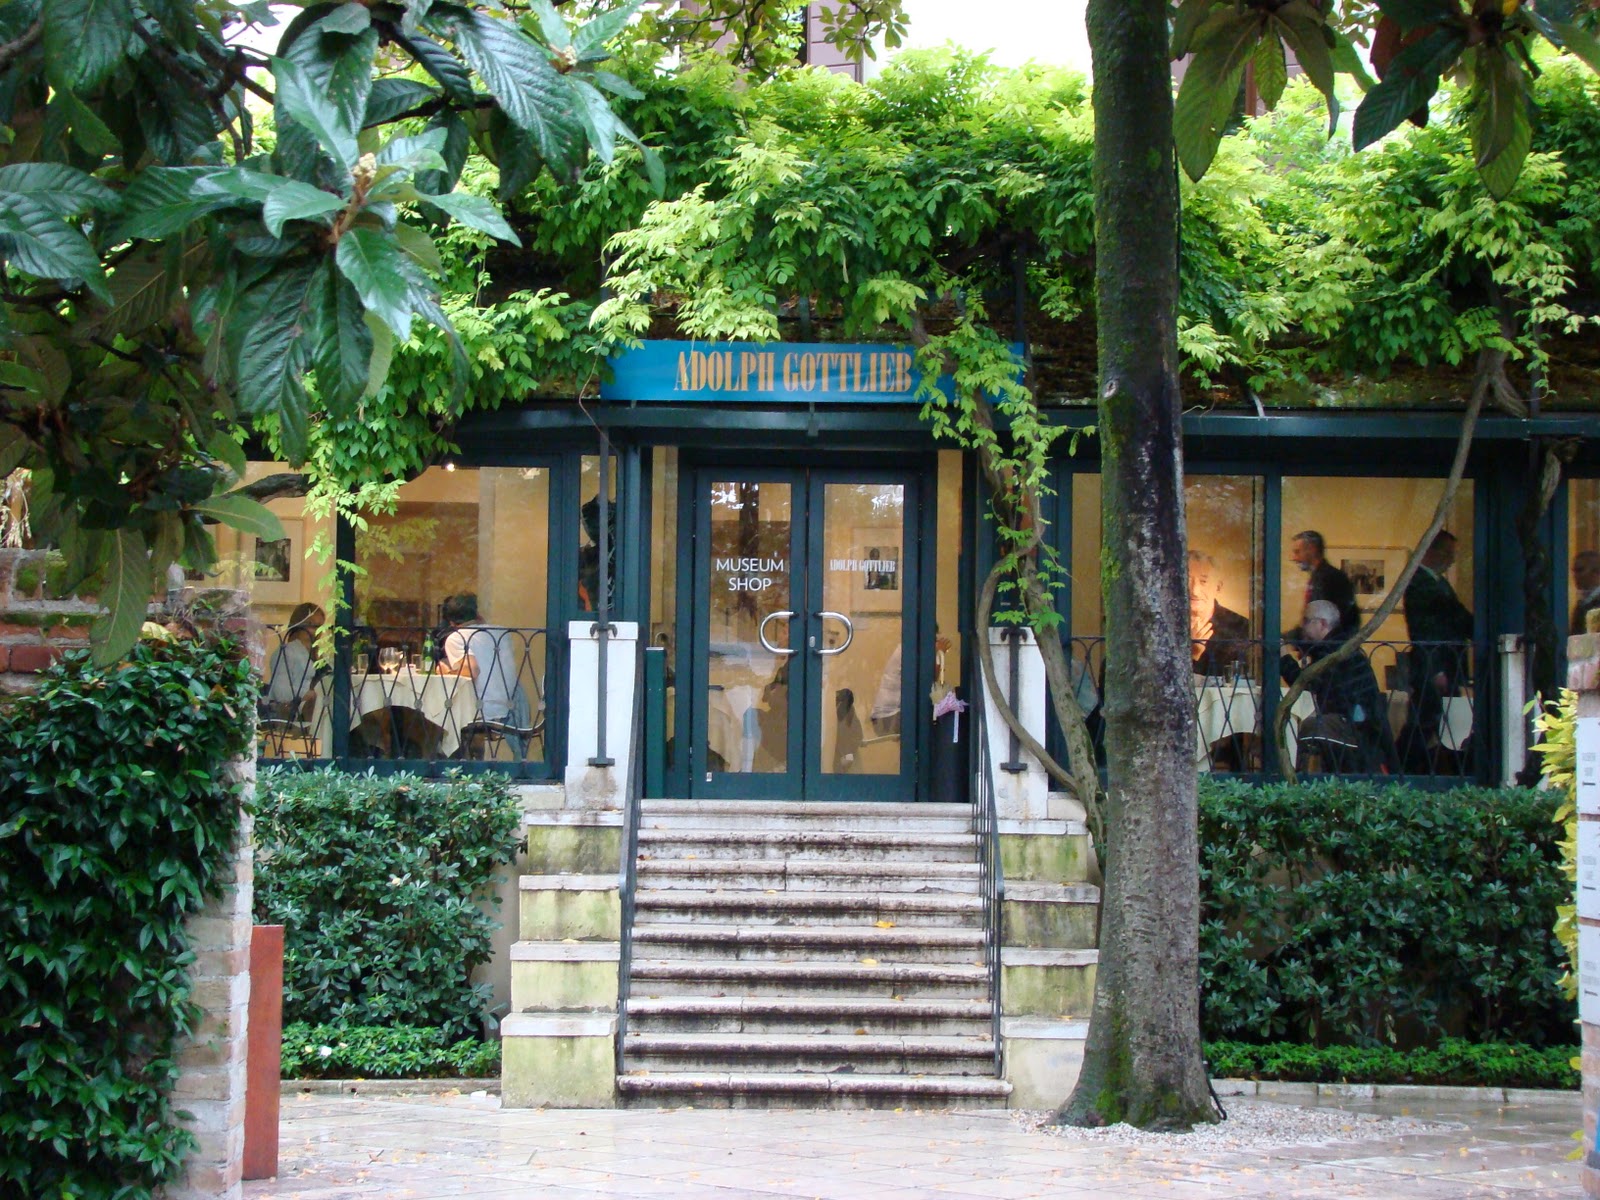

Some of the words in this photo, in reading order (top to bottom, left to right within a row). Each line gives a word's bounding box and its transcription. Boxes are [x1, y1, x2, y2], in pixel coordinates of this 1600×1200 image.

[674, 351, 775, 391] ADOLPH
[783, 352, 911, 392] GOTTLIEB
[716, 558, 784, 572] MUSEUM
[728, 577, 772, 591] SHOP
